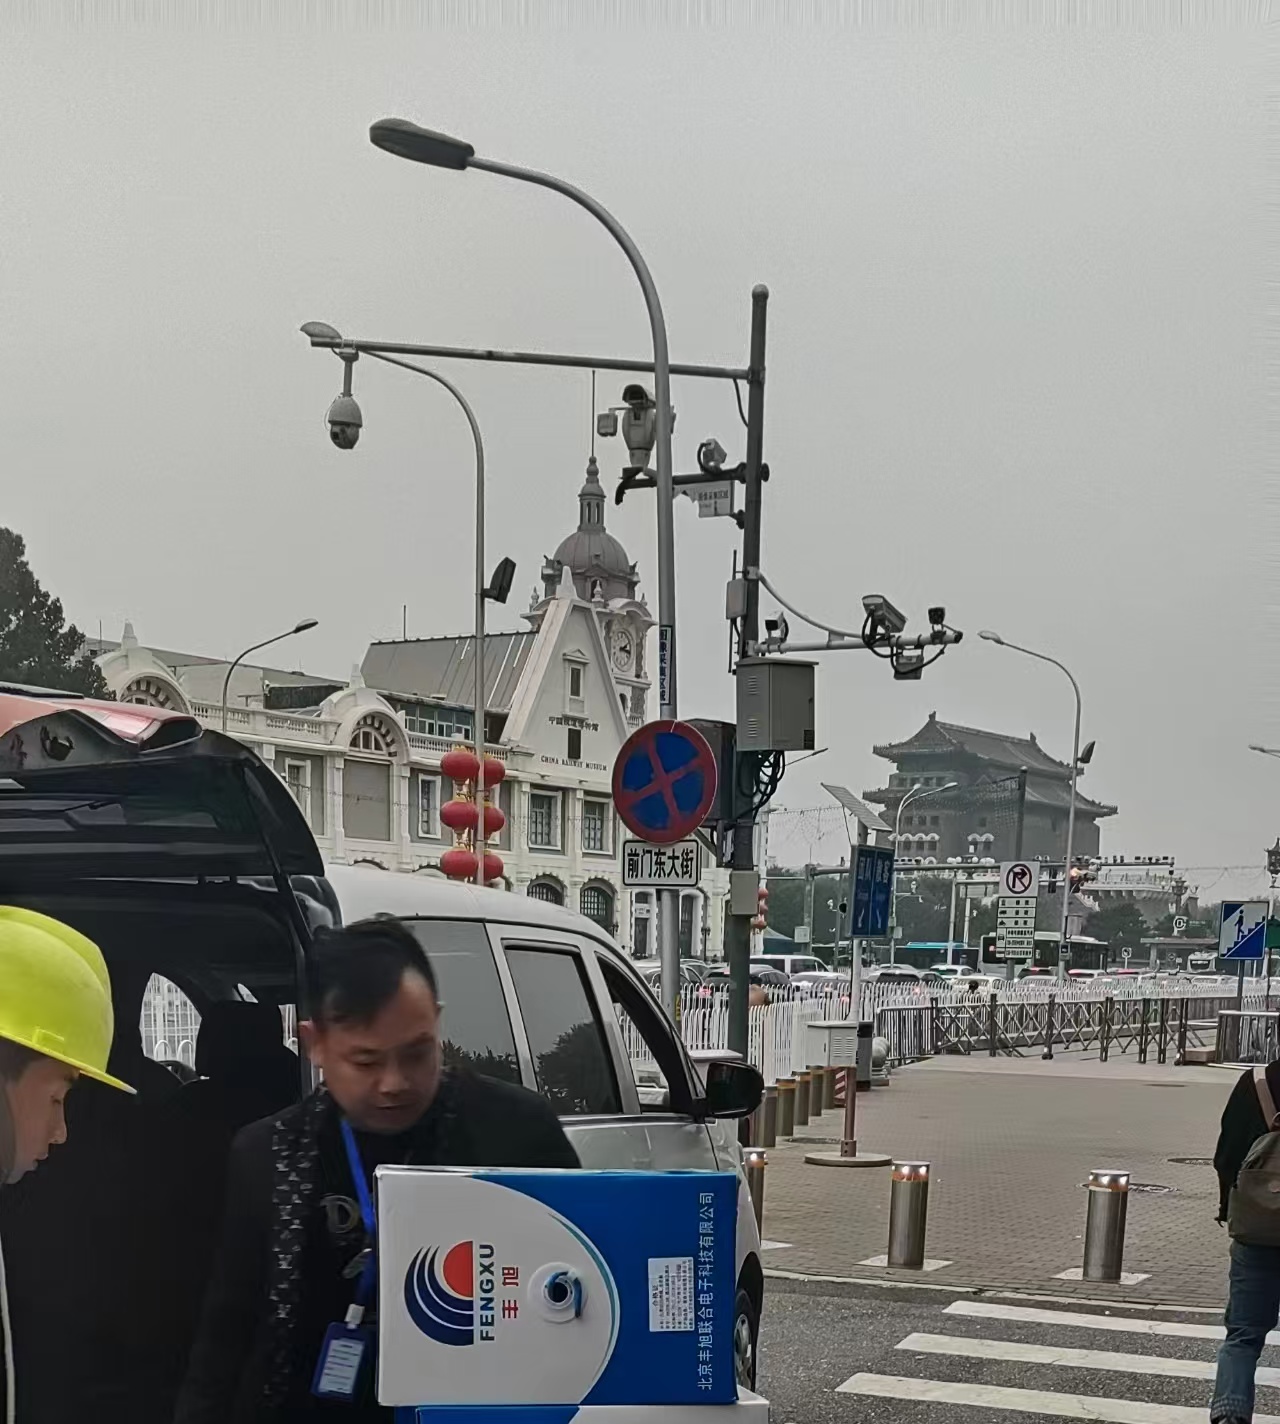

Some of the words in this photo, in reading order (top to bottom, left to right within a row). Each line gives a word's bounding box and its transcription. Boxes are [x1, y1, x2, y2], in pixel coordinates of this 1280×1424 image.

[540, 755, 559, 765] CHINA
[562, 759, 583, 769] RAILWAY
[585, 762, 607, 771] MUSEUM
[627, 848, 694, 879] 前门东大街
[479, 1243, 495, 1342] FENGXU
[697, 1192, 714, 1391] 北京丰旭联合电子科技有限公司
